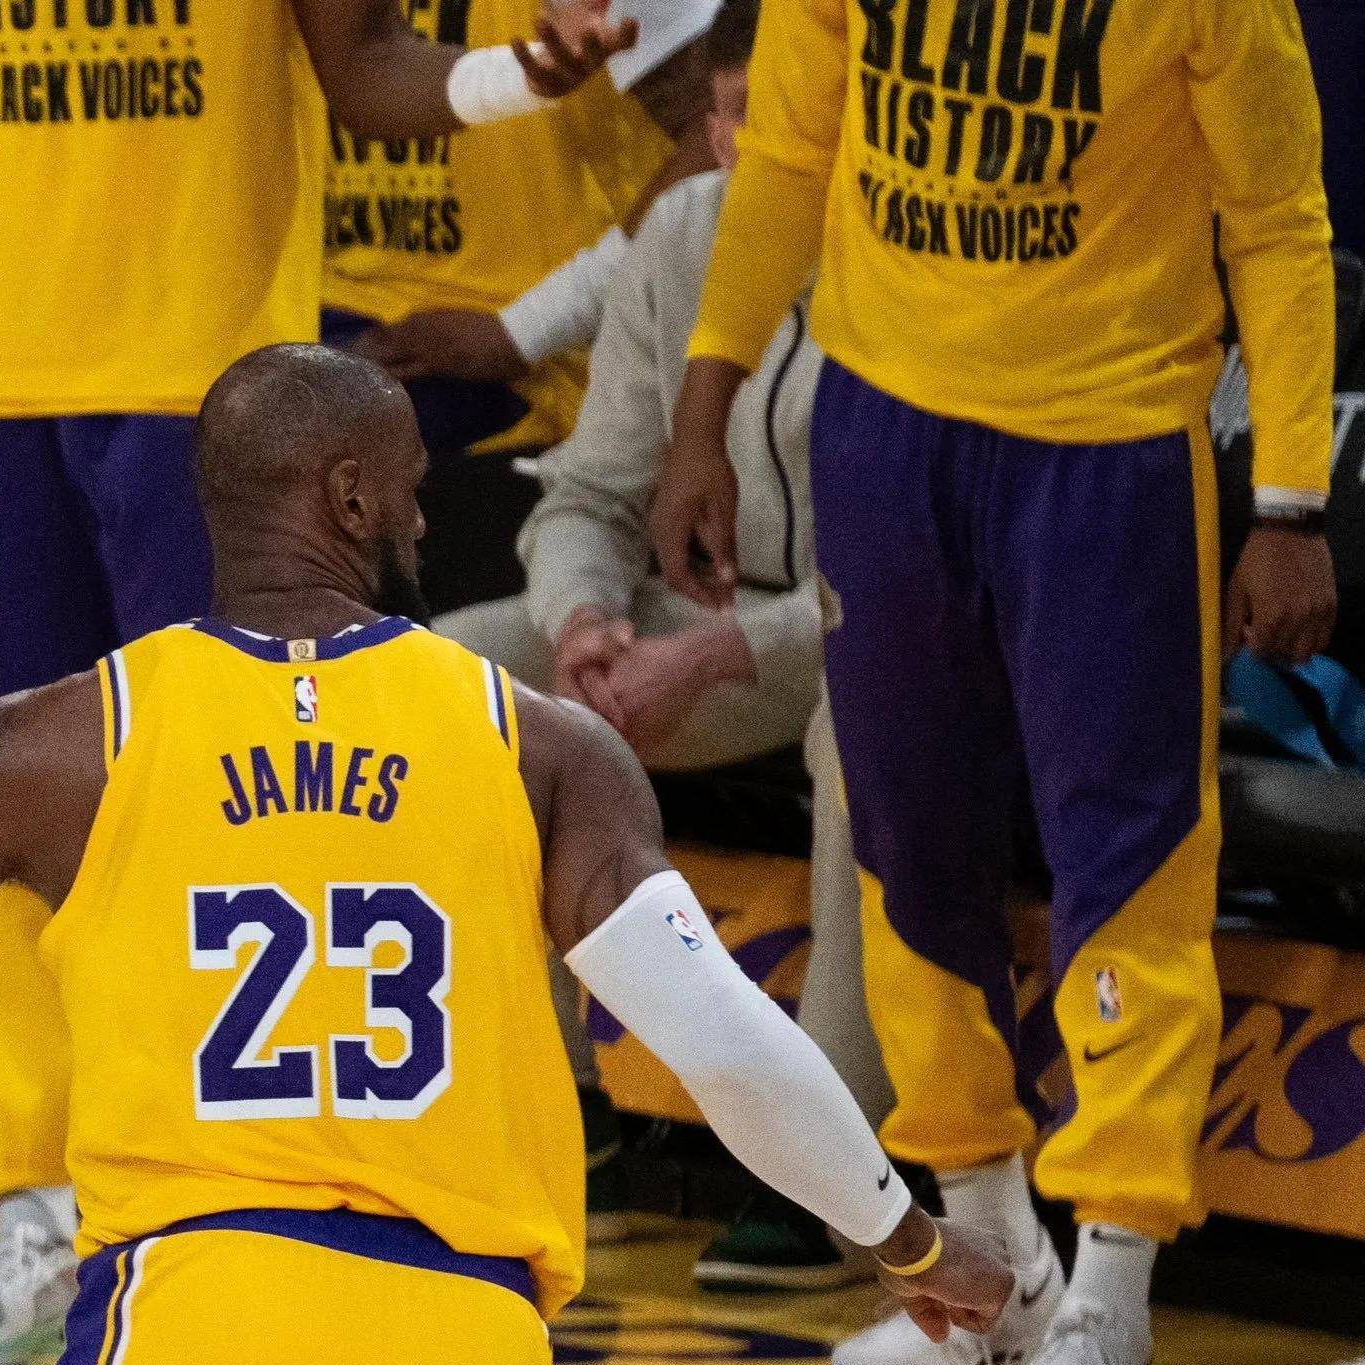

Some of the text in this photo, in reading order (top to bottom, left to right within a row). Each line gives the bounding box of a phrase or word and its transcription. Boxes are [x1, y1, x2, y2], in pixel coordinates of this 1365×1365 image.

[78, 57, 204, 120] VOICES
[955, 201, 1081, 263] VOICES
[219, 741, 409, 826] JAMES
[187, 881, 453, 1121] 23
